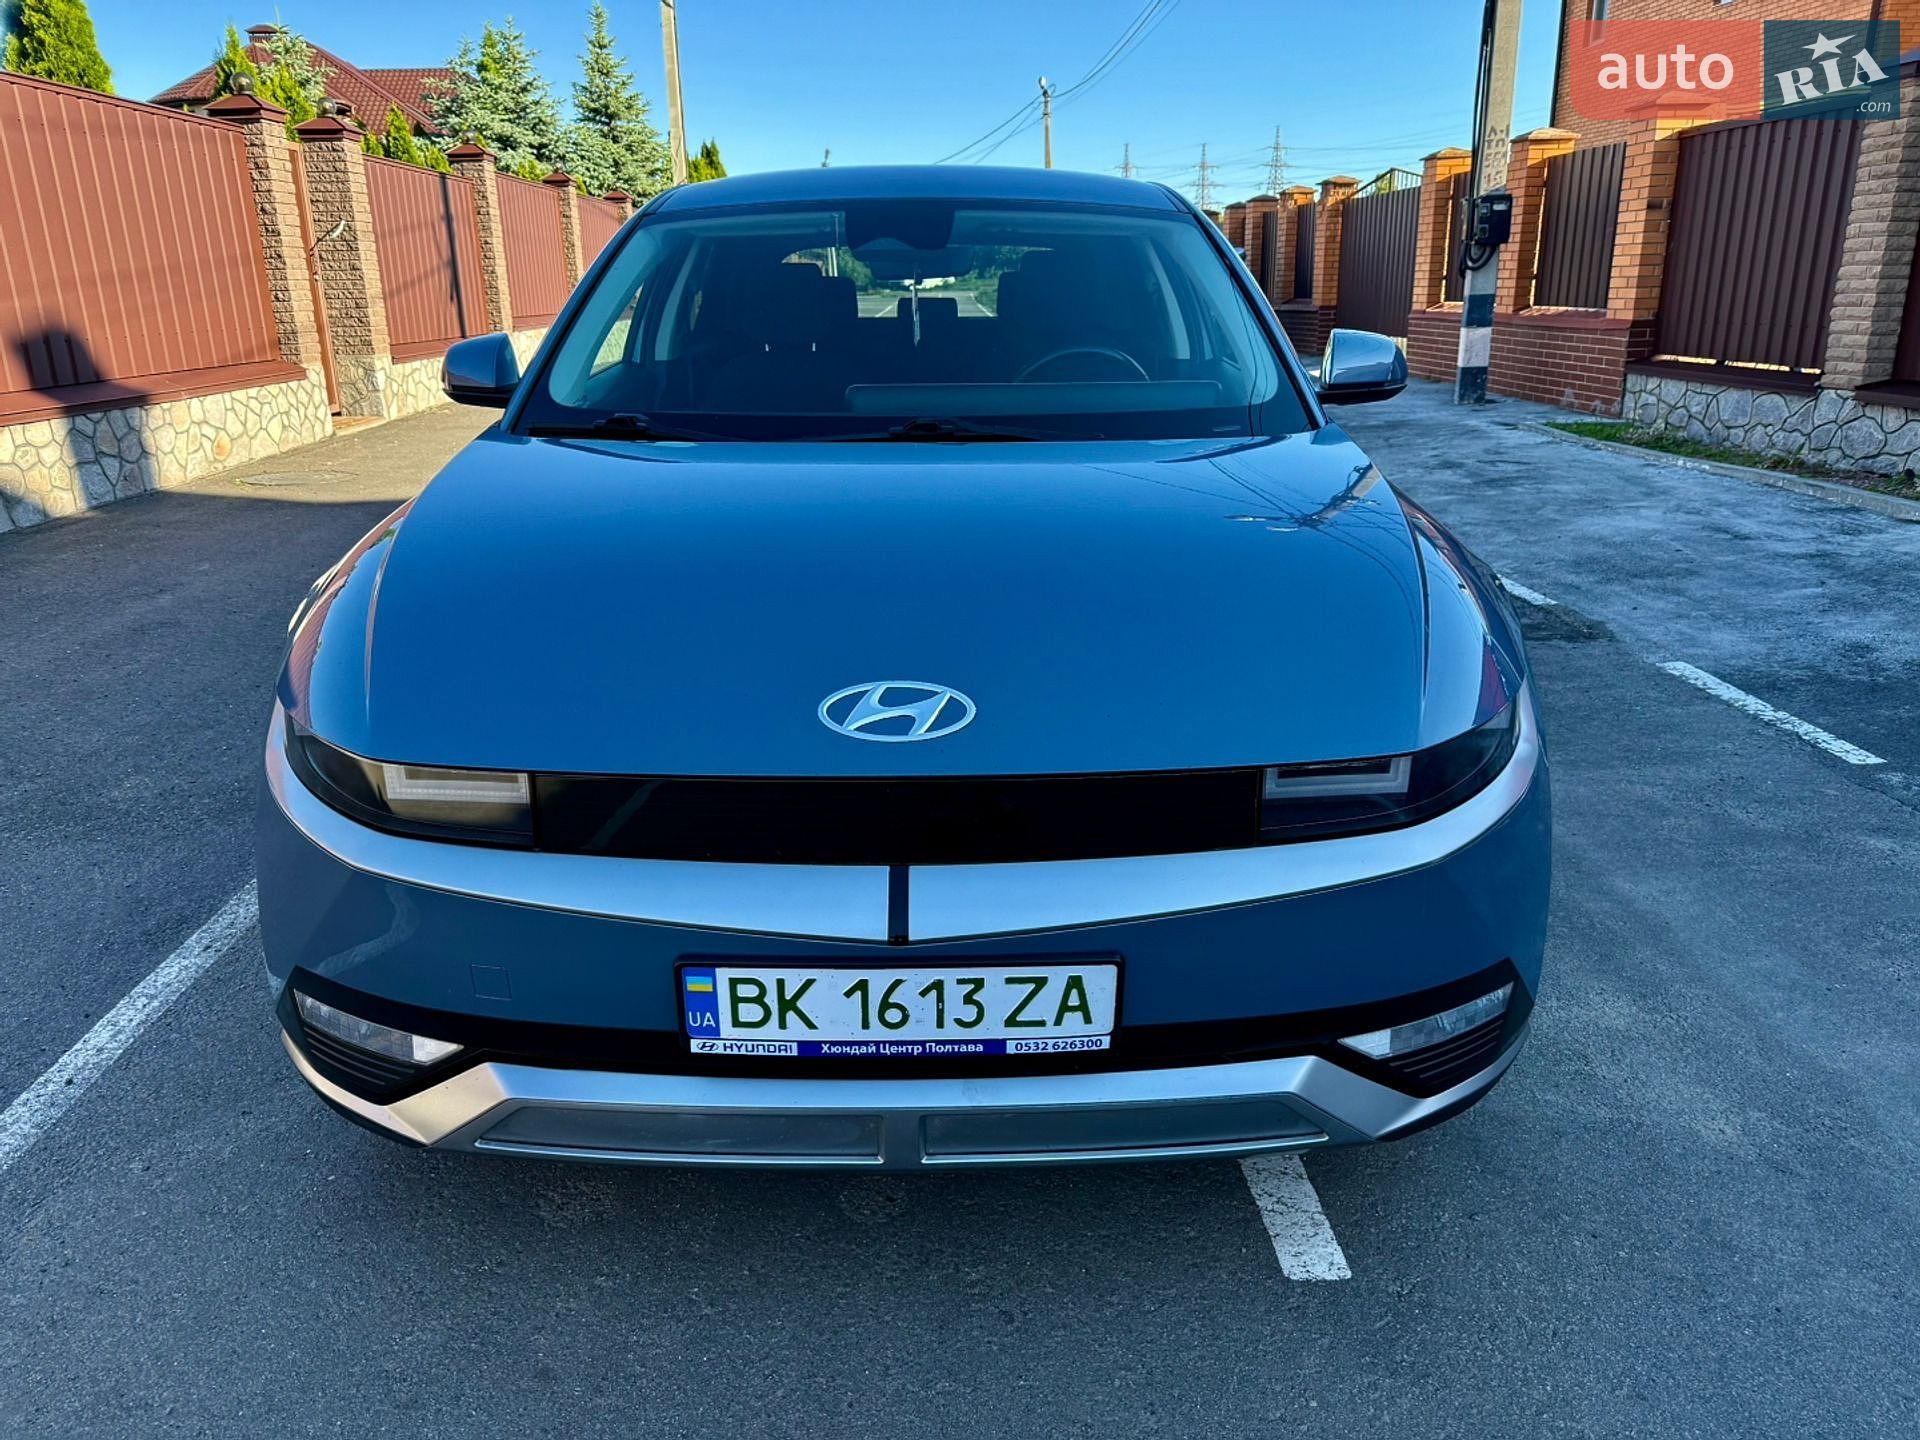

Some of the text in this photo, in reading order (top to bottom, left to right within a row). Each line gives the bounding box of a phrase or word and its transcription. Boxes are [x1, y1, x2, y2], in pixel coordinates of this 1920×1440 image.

[728, 975, 1093, 1030] BK 1613 ZA
[689, 1012, 716, 1029] UA
[723, 1043, 793, 1055] HYUNDAI
[821, 1042, 984, 1055] Хюндай Центр Полтава
[1014, 1038, 1103, 1052] 0532 626300
